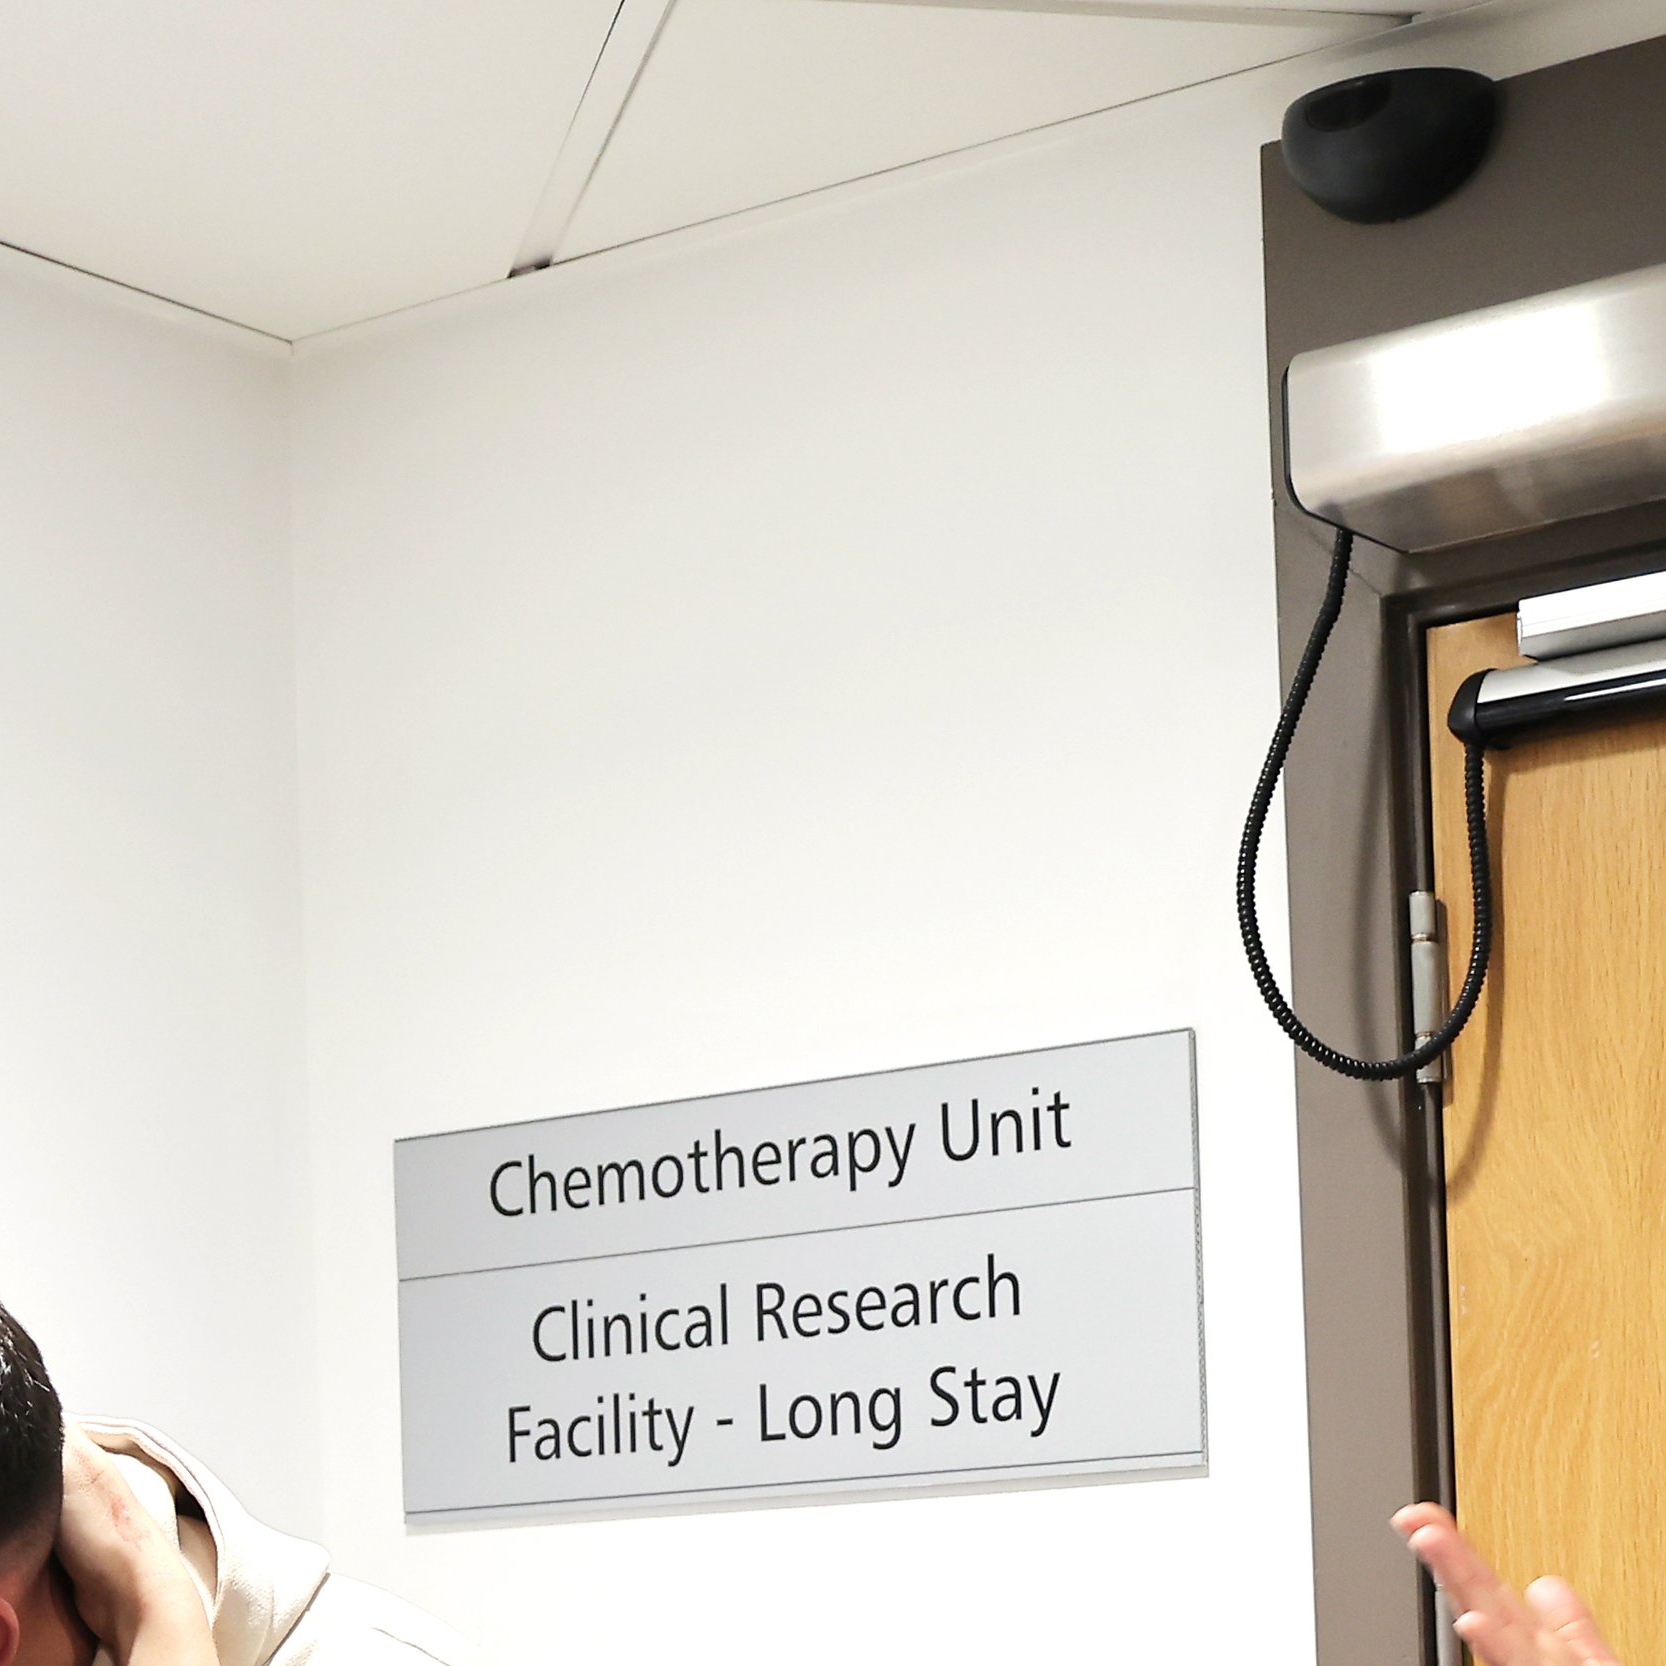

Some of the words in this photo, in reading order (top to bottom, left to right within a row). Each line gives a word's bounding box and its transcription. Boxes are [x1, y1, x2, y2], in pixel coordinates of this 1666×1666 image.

[490, 1123, 916, 1217] Chemotherapy
[941, 1087, 1071, 1162] Unit
[532, 1283, 729, 1362] Clinical
[756, 1253, 1020, 1342] Research
[508, 1393, 695, 1467] Facility
[716, 1418, 733, 1426] -
[759, 1384, 901, 1450] Long
[930, 1365, 1061, 1438] Stay
